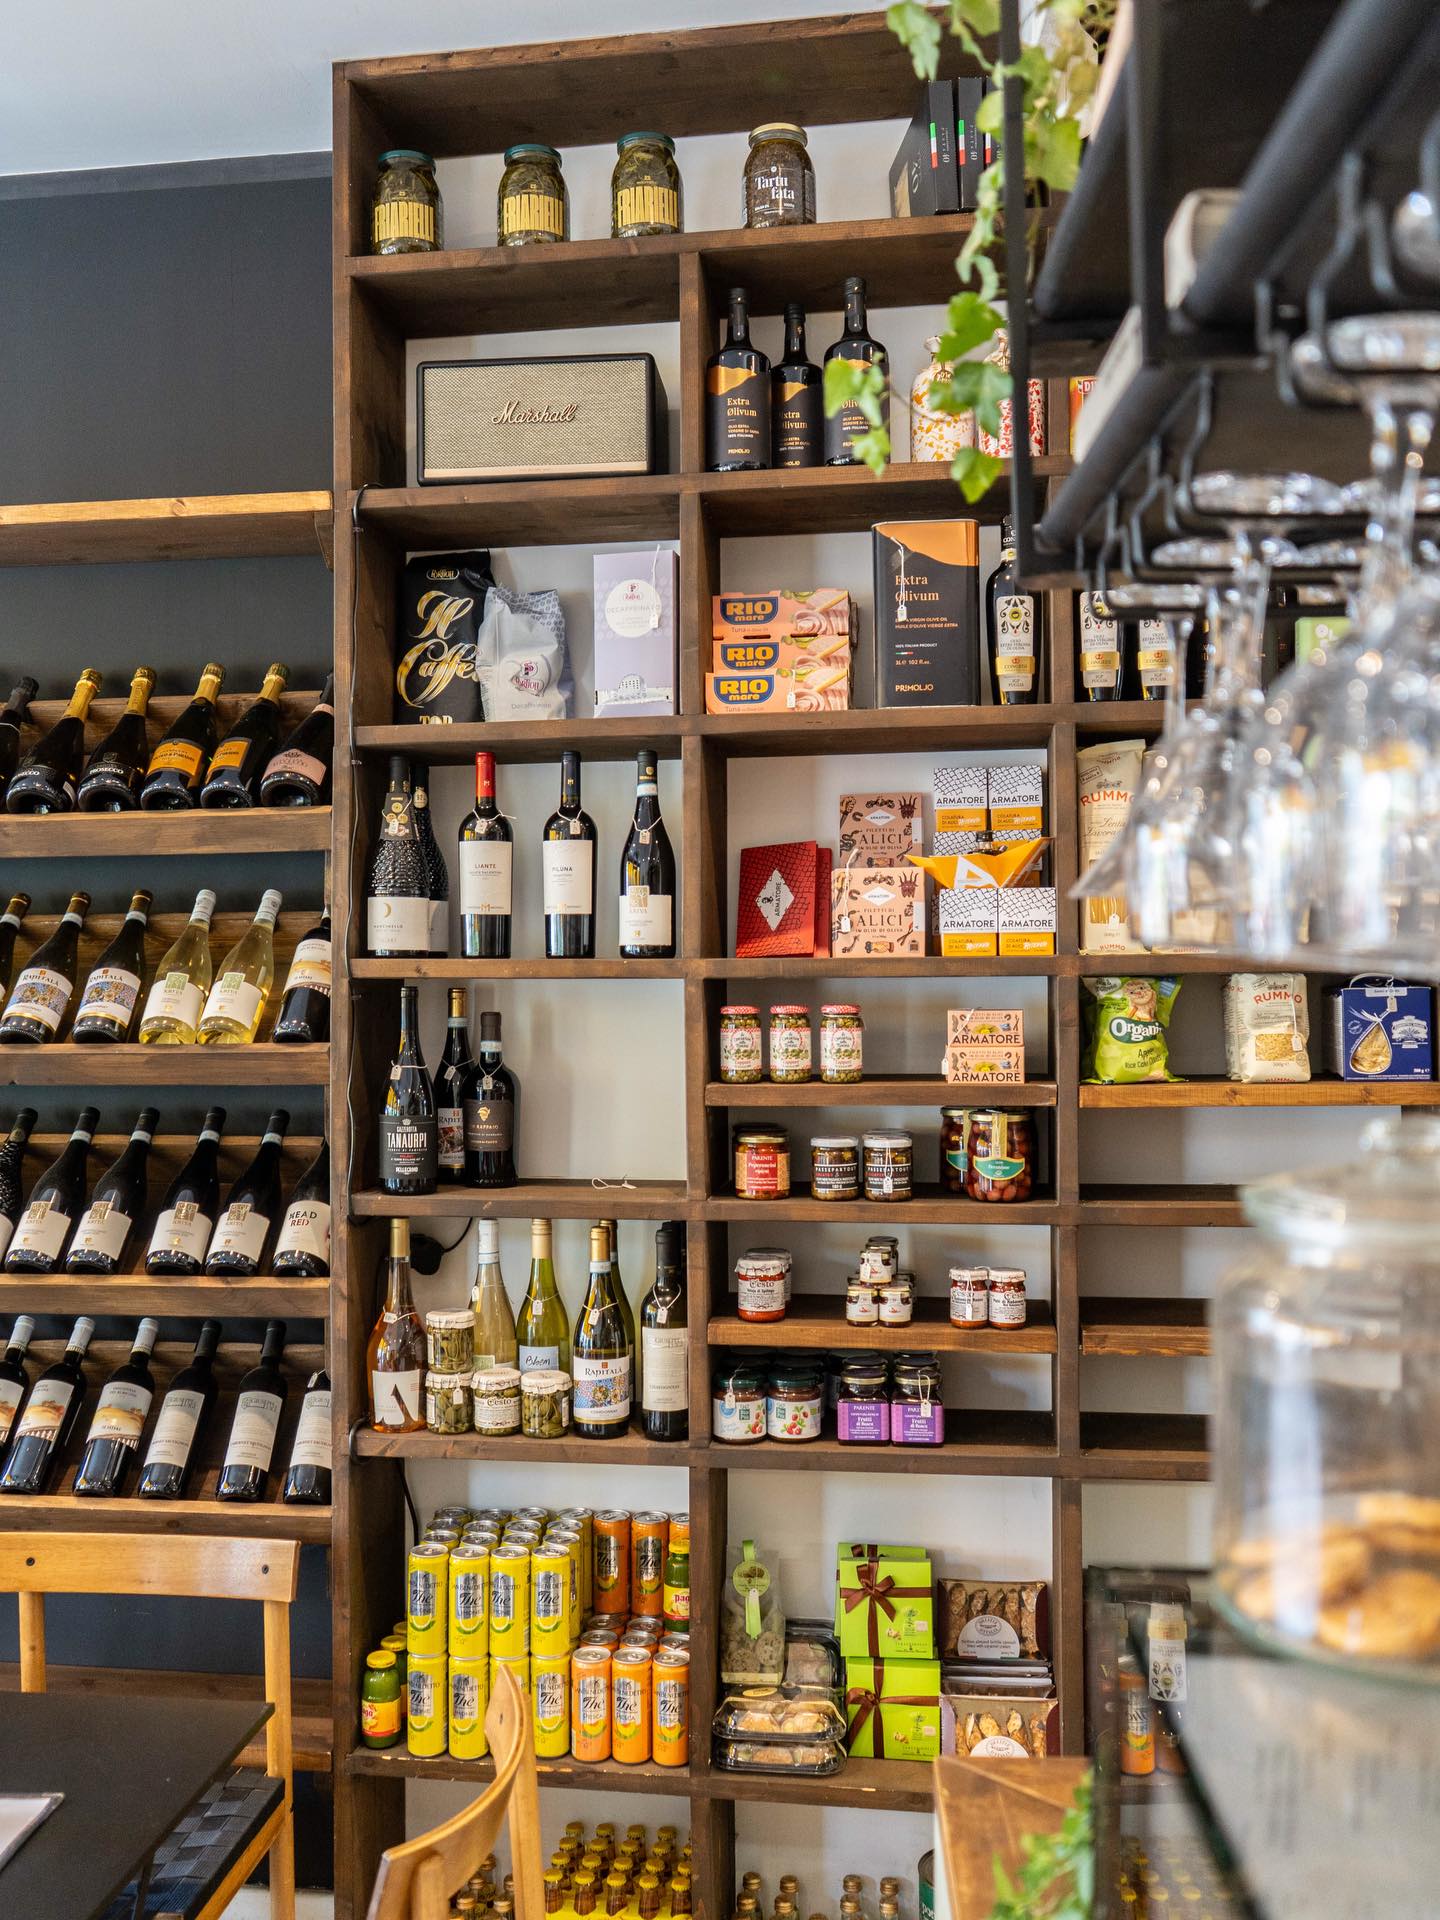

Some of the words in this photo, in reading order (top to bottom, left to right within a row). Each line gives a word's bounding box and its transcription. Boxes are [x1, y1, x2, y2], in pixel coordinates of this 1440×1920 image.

[755, 175, 788, 189] Tartu
[771, 187, 795, 199] fata
[727, 397, 750, 406] Extra
[842, 398, 862, 410] Øliv
[491, 399, 577, 424] Marshall
[727, 407, 757, 417] Ølivum
[895, 575, 929, 586] Extra
[895, 590, 940, 602] Ølivum
[726, 601, 773, 615] RIO
[735, 614, 765, 622] mare
[727, 646, 774, 661] RIO
[736, 659, 766, 667] mare
[719, 679, 769, 694] RIO
[729, 693, 760, 701] mare
[89, 767, 124, 775] PROSECCO
[936, 796, 985, 804] ARMATORE
[991, 794, 1040, 803] ARMATORE
[859, 834, 903, 845] ALICI
[774, 882, 782, 917] ARMATORE
[857, 914, 903, 927] ALICI
[943, 920, 996, 928] ARMATORE
[1001, 919, 1054, 928] ARMATORE
[1099, 943, 1126, 951] RUMMO
[1253, 992, 1303, 1004] RUMMO
[952, 1034, 1021, 1044] ARMATORE
[952, 1072, 1021, 1082] ARMATORE
[387, 1132, 427, 1149] TANAURPI
[291, 1218, 310, 1227] RED
[674, 1594, 689, 1604] pag
